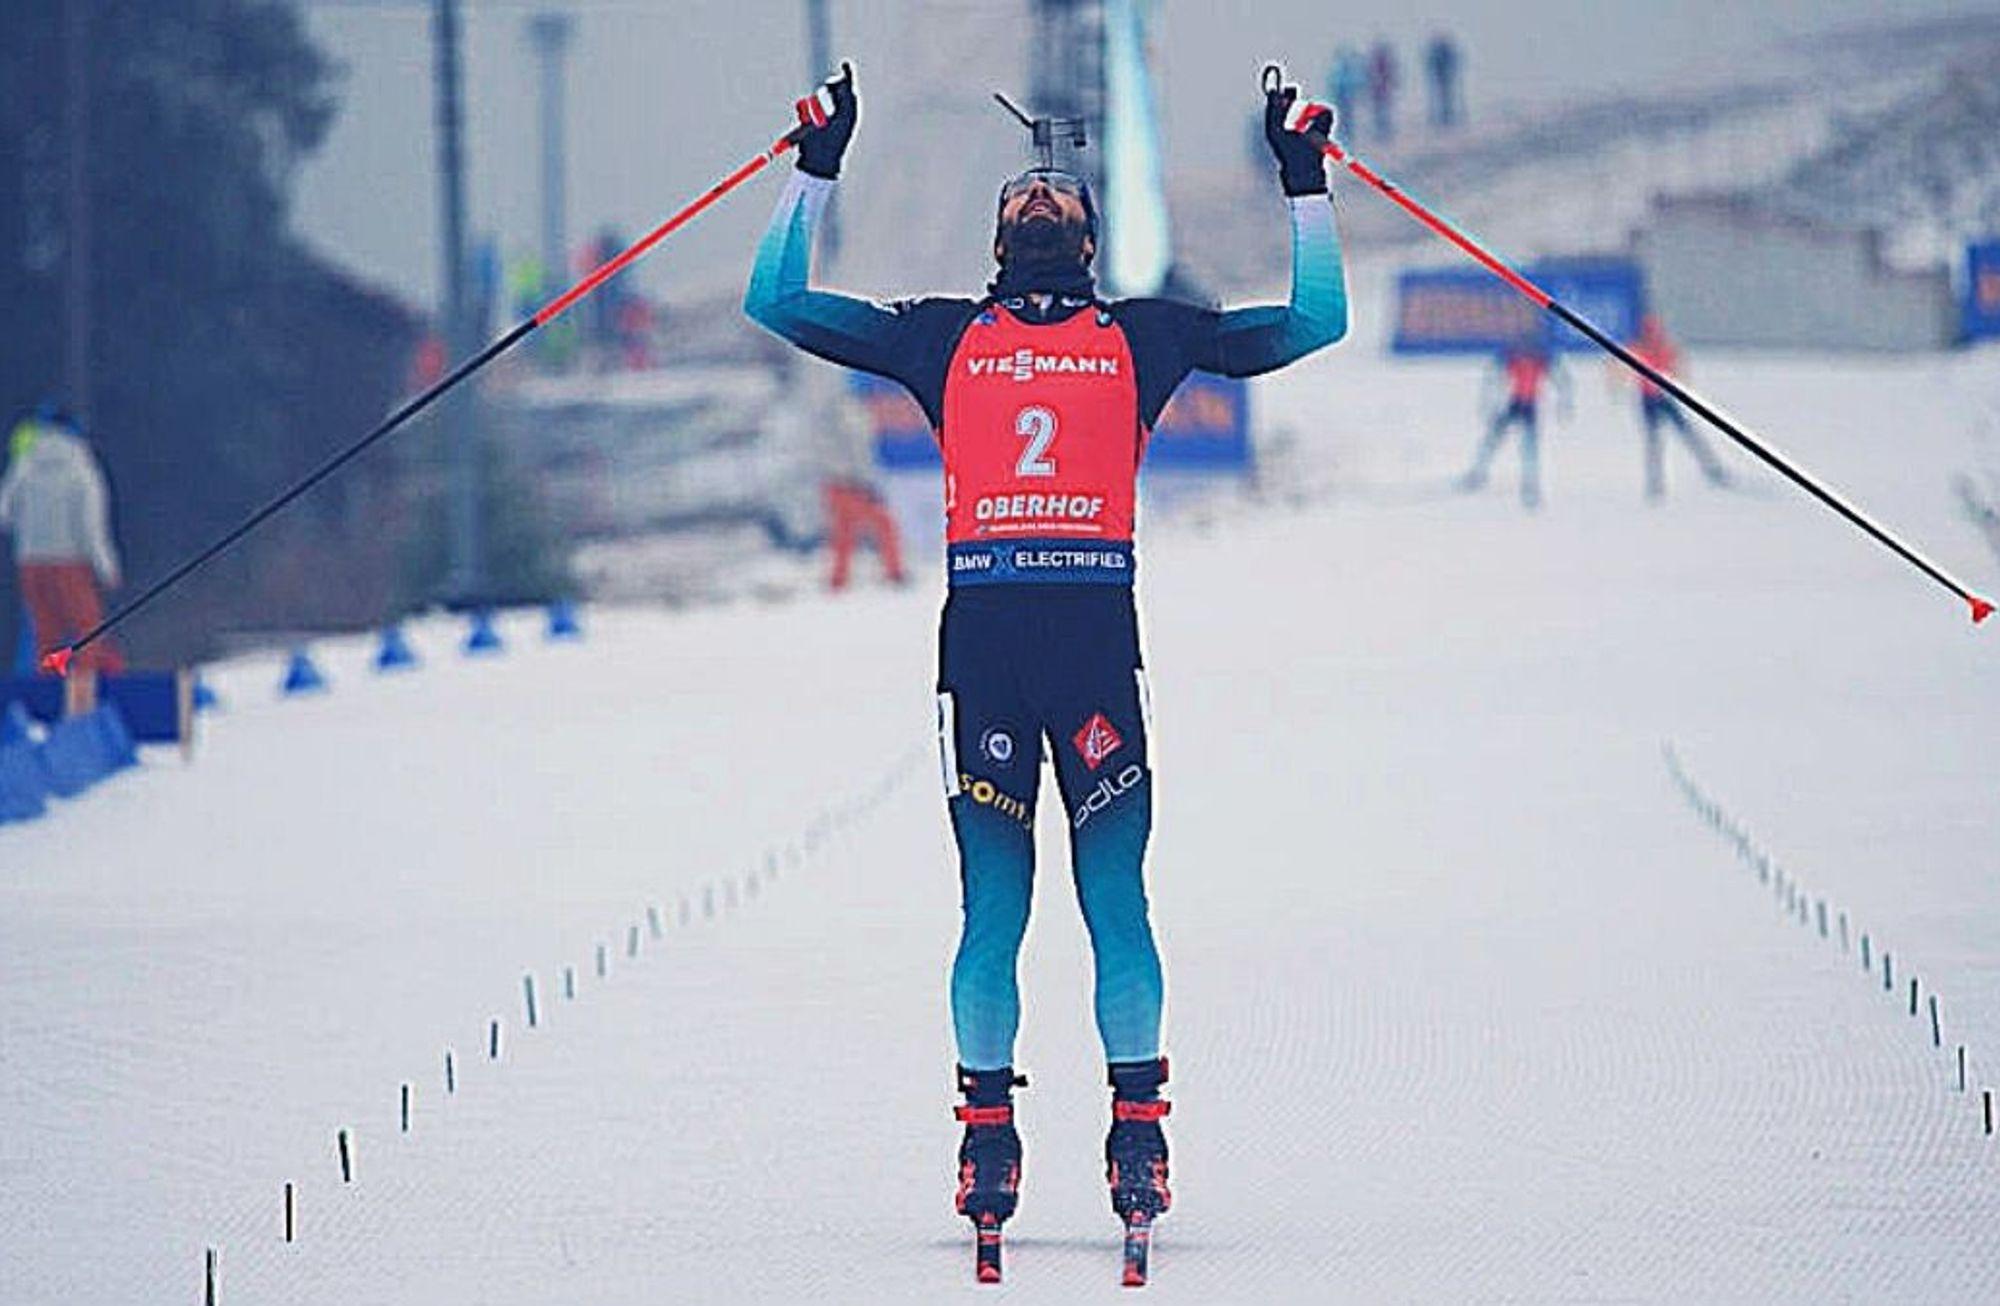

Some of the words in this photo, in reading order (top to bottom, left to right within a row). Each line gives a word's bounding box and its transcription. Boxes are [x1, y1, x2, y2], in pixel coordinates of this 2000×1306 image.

[967, 349, 1118, 382] VIESSMANN
[1016, 405, 1058, 477] 2
[976, 494, 1103, 520] OBERHOF
[954, 555, 992, 570] BMW
[1015, 551, 1126, 568] ELECTRIFIED
